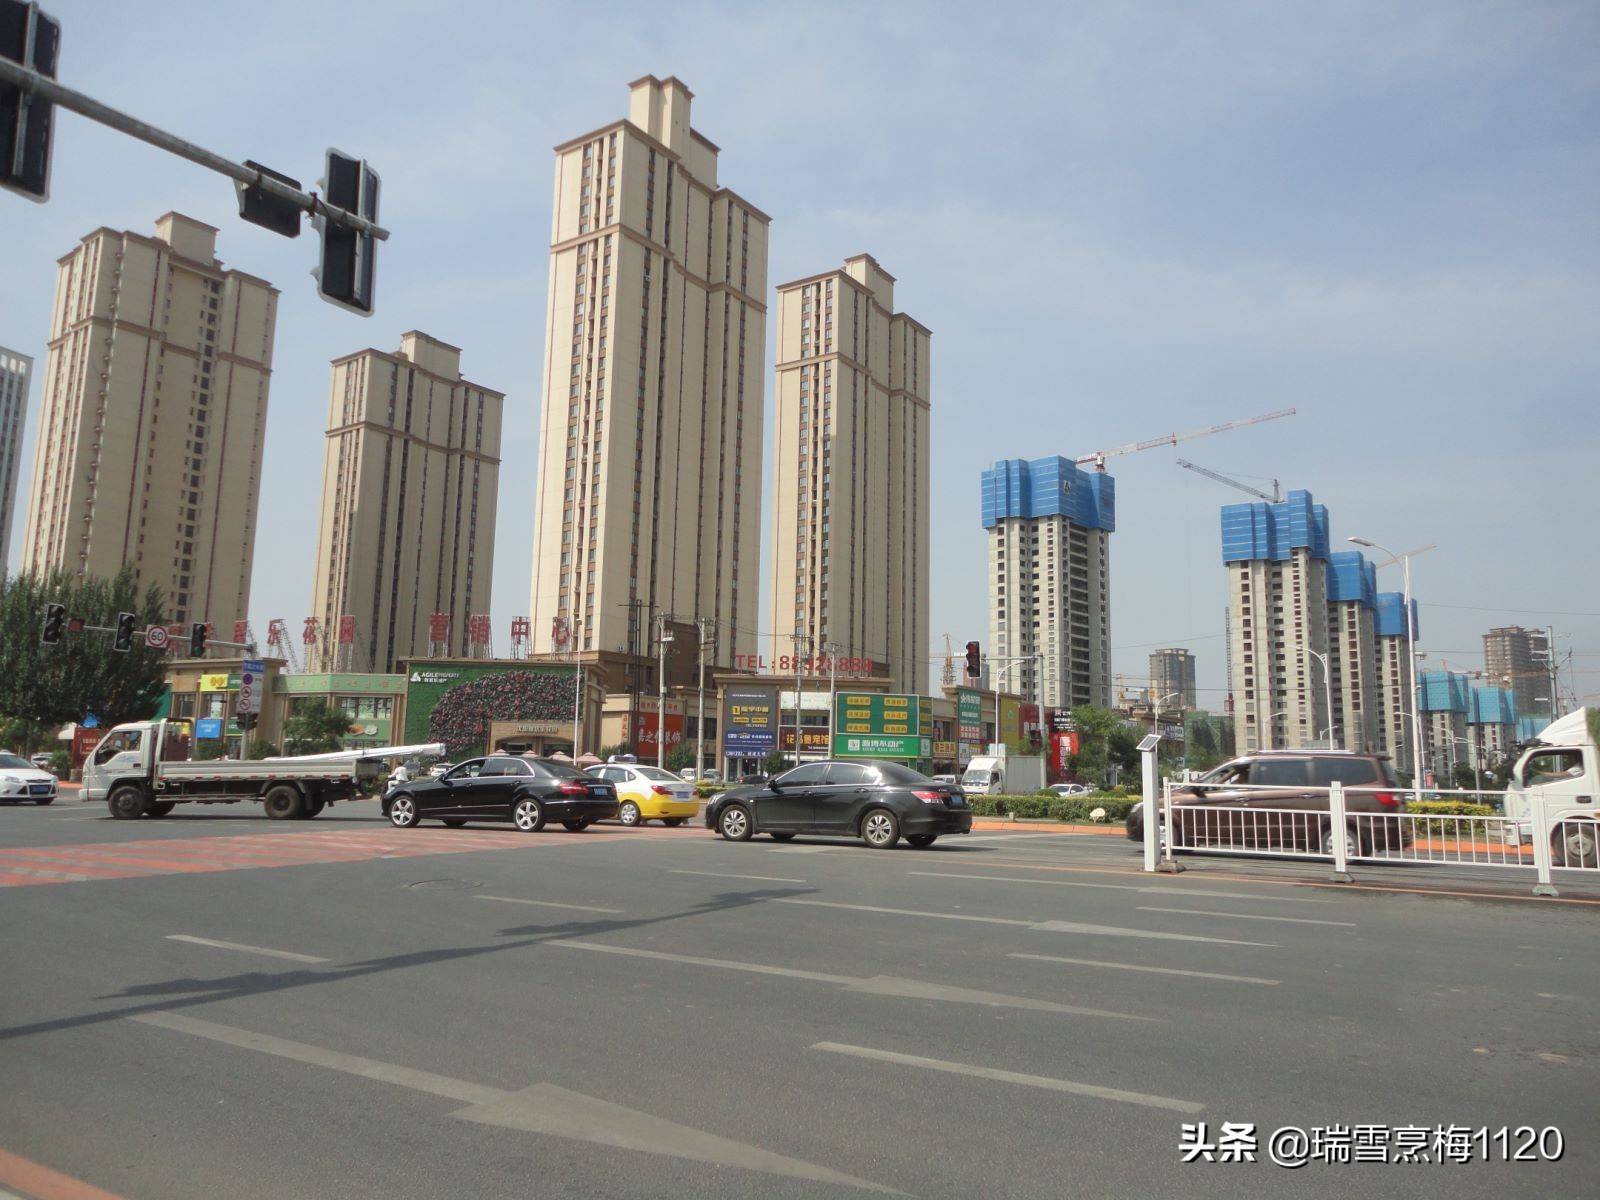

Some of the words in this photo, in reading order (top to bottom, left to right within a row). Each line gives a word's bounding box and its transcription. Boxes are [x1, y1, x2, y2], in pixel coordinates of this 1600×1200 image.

[151, 631, 163, 641] 60
[430, 613, 570, 646] 营销中心
